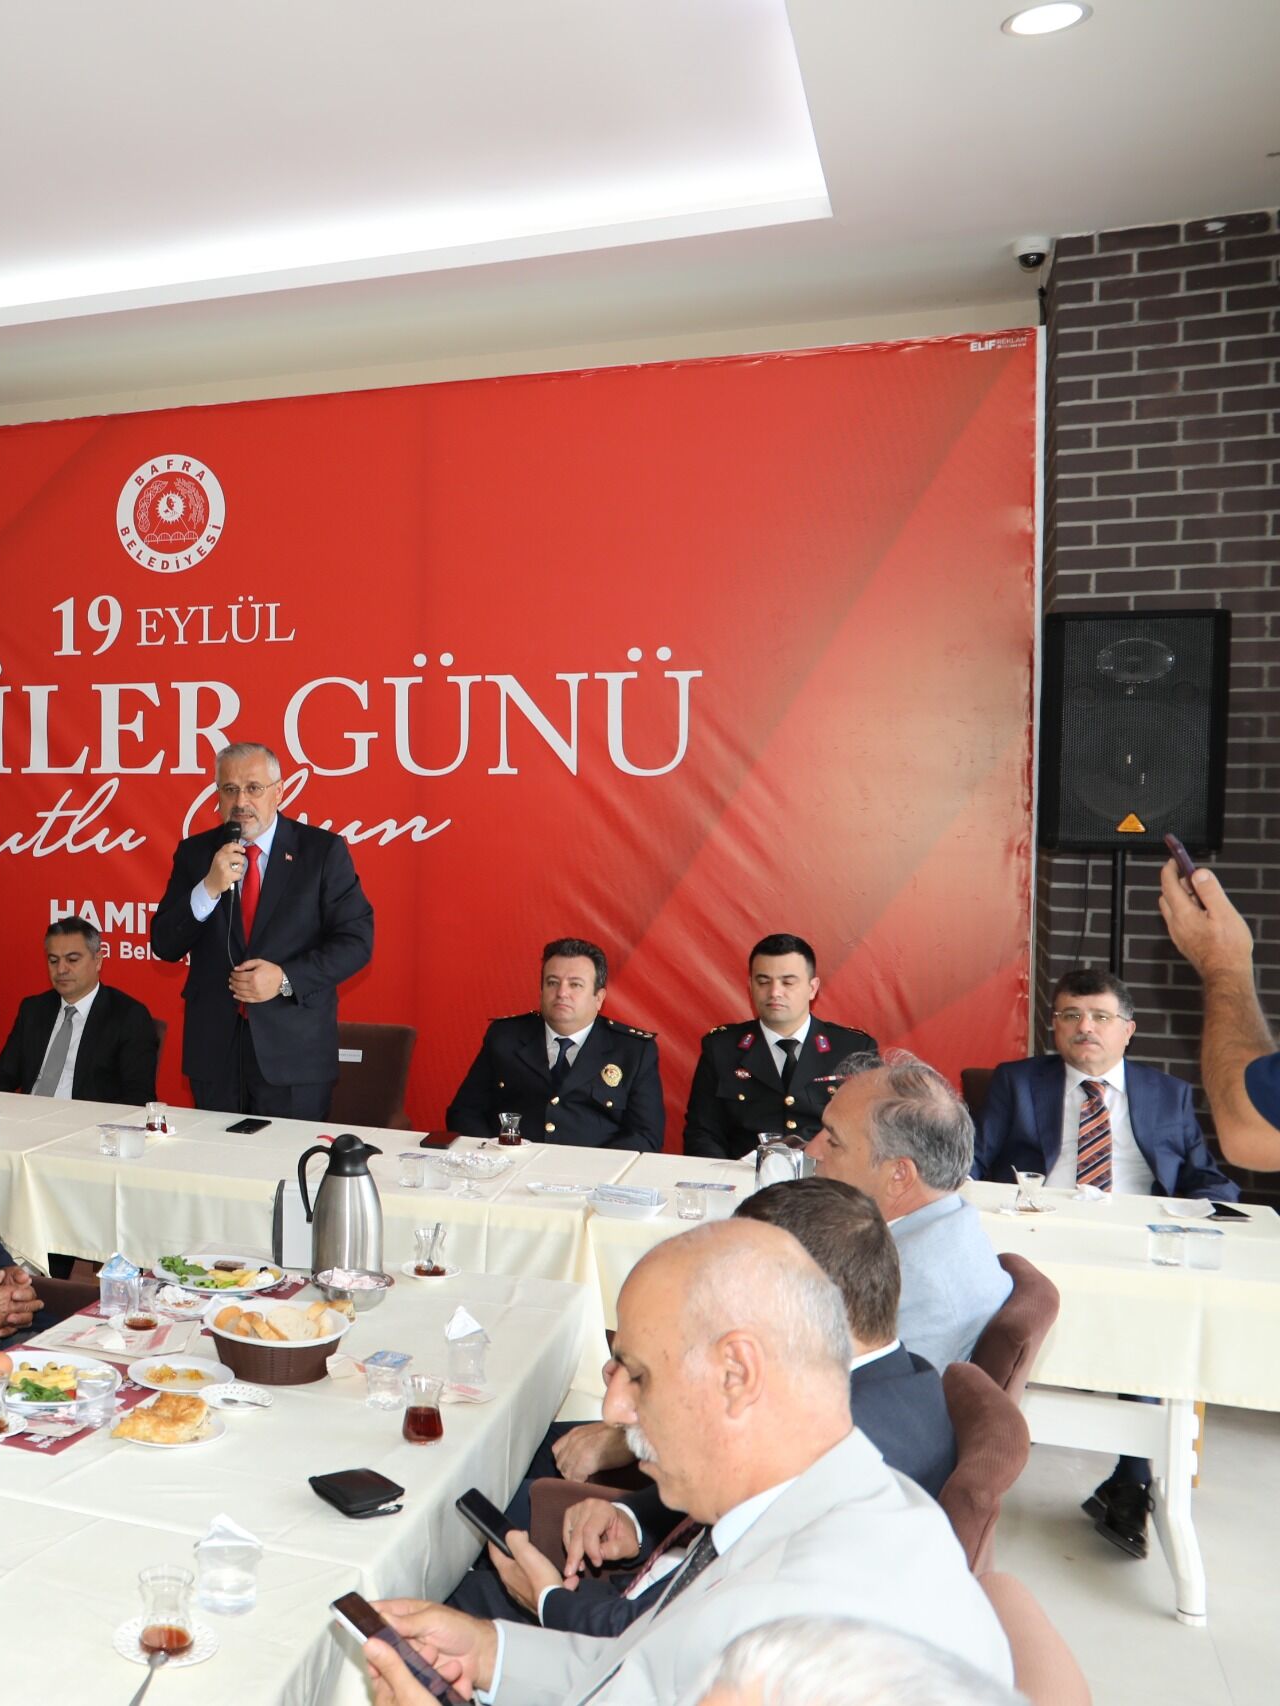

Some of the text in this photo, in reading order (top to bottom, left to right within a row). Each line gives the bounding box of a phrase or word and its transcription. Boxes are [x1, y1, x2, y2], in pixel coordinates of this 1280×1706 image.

[135, 459, 206, 487] BAFRA
[120, 524, 221, 570] BELEDİYESİ
[51, 595, 296, 656] 19 EYLÜL
[283, 646, 703, 777] GÜNÜ
